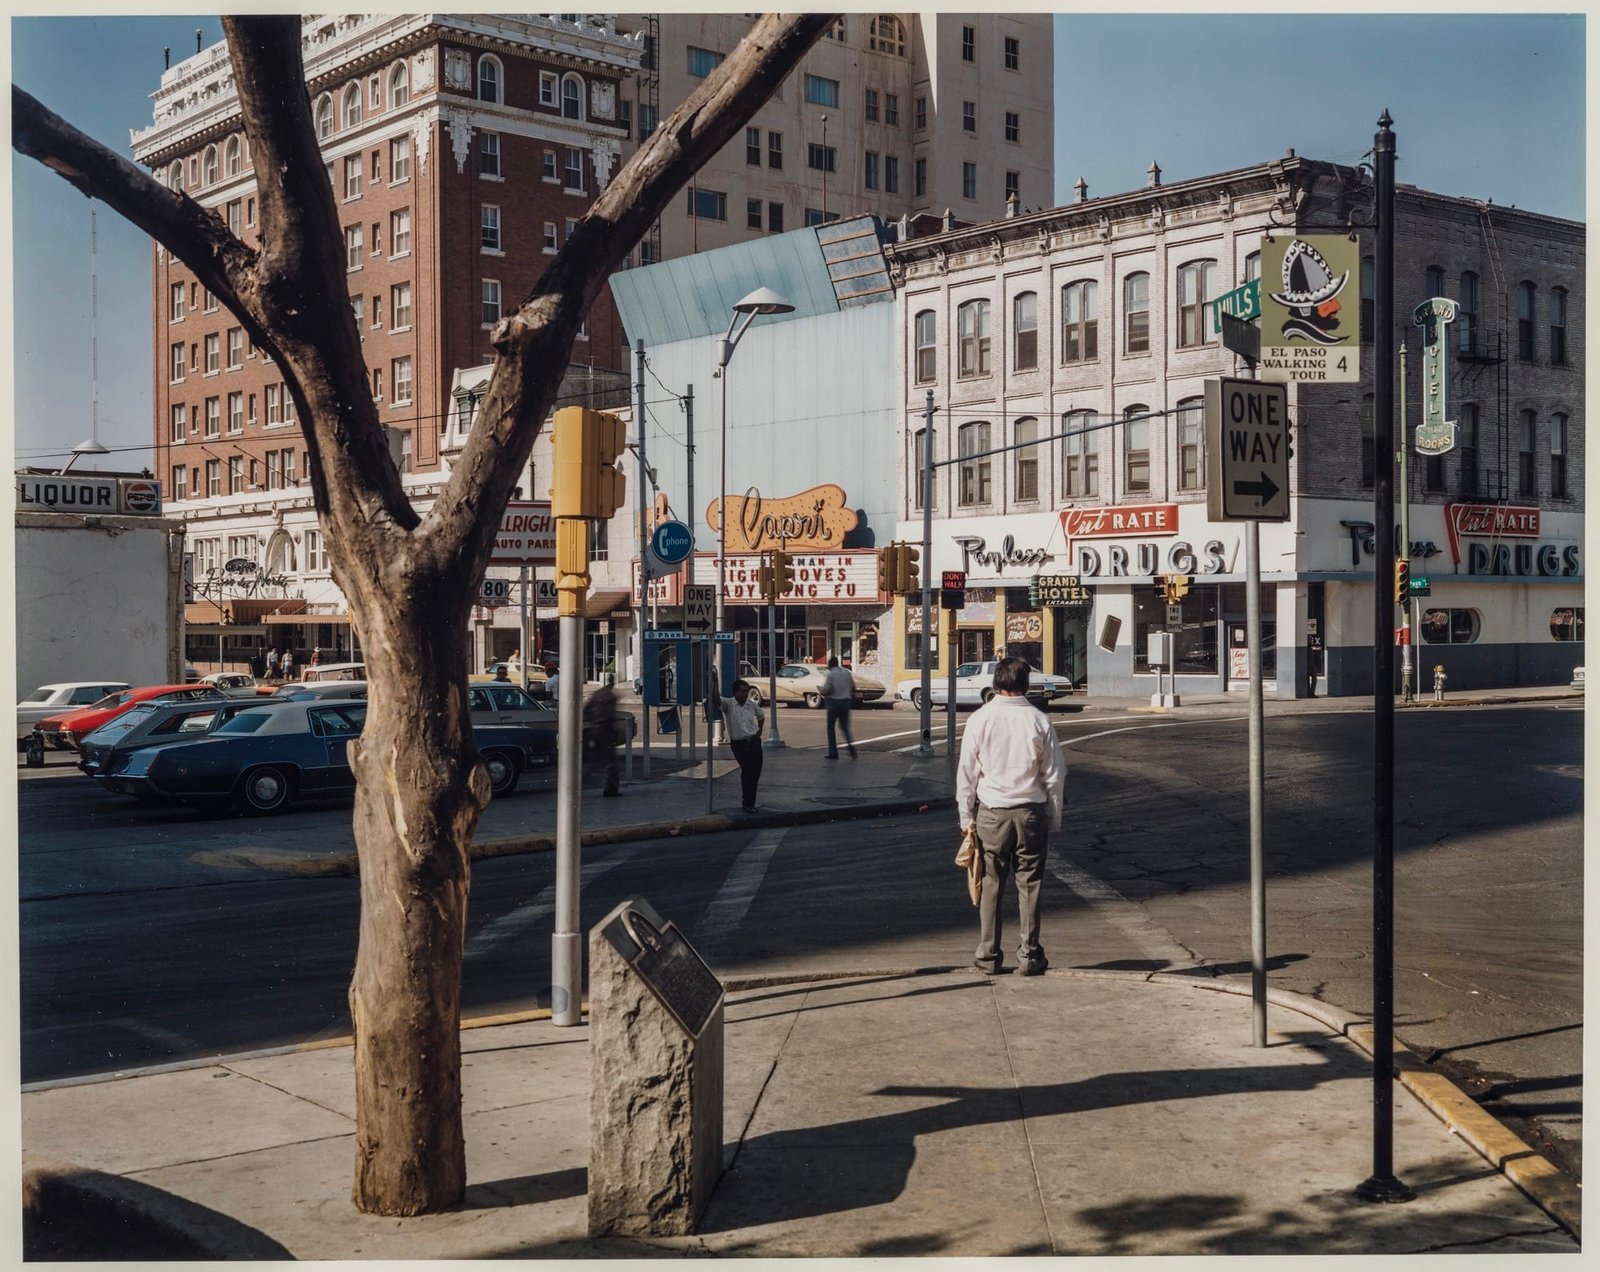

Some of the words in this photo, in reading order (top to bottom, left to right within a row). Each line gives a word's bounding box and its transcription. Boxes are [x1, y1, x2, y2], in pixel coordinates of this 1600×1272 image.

[1217, 288, 1251, 327] MILLS
[1415, 305, 1453, 324] GRAND
[1271, 348, 1287, 357] EL
[1294, 348, 1327, 357] PASO
[1263, 359, 1327, 369] WALKING
[1337, 356, 1348, 373] 4
[1429, 326, 1440, 415] HOTEL
[1290, 371, 1327, 380] TOUR
[1230, 391, 1280, 426] ONE
[1229, 430, 1281, 464] WAY
[1418, 435, 1450, 449] ROOMS
[21, 483, 111, 506] LIQUOR
[127, 492, 156, 502] PEPSI
[740, 486, 832, 549] Capri
[1065, 507, 1110, 536] Cut
[1112, 510, 1166, 530] RATE
[1456, 503, 1495, 532] Cut
[1496, 514, 1537, 530] RATE
[492, 539, 522, 549] AUTO
[666, 536, 689, 546] phone
[1340, 520, 1442, 565] Palss
[838, 557, 852, 566] IN
[951, 534, 1054, 576] Payless
[1078, 540, 1226, 577] DRUGS
[1469, 543, 1579, 575] DRUGS
[723, 569, 759, 583] IGH
[944, 573, 963, 581] DONT
[1038, 576, 1078, 586] GRAND
[540, 583, 558, 597] 40
[688, 589, 711, 600] ONE
[723, 585, 755, 598] ADY
[834, 584, 856, 597] FU
[1038, 587, 1090, 600] HOTEL
[687, 604, 712, 615] WAY
